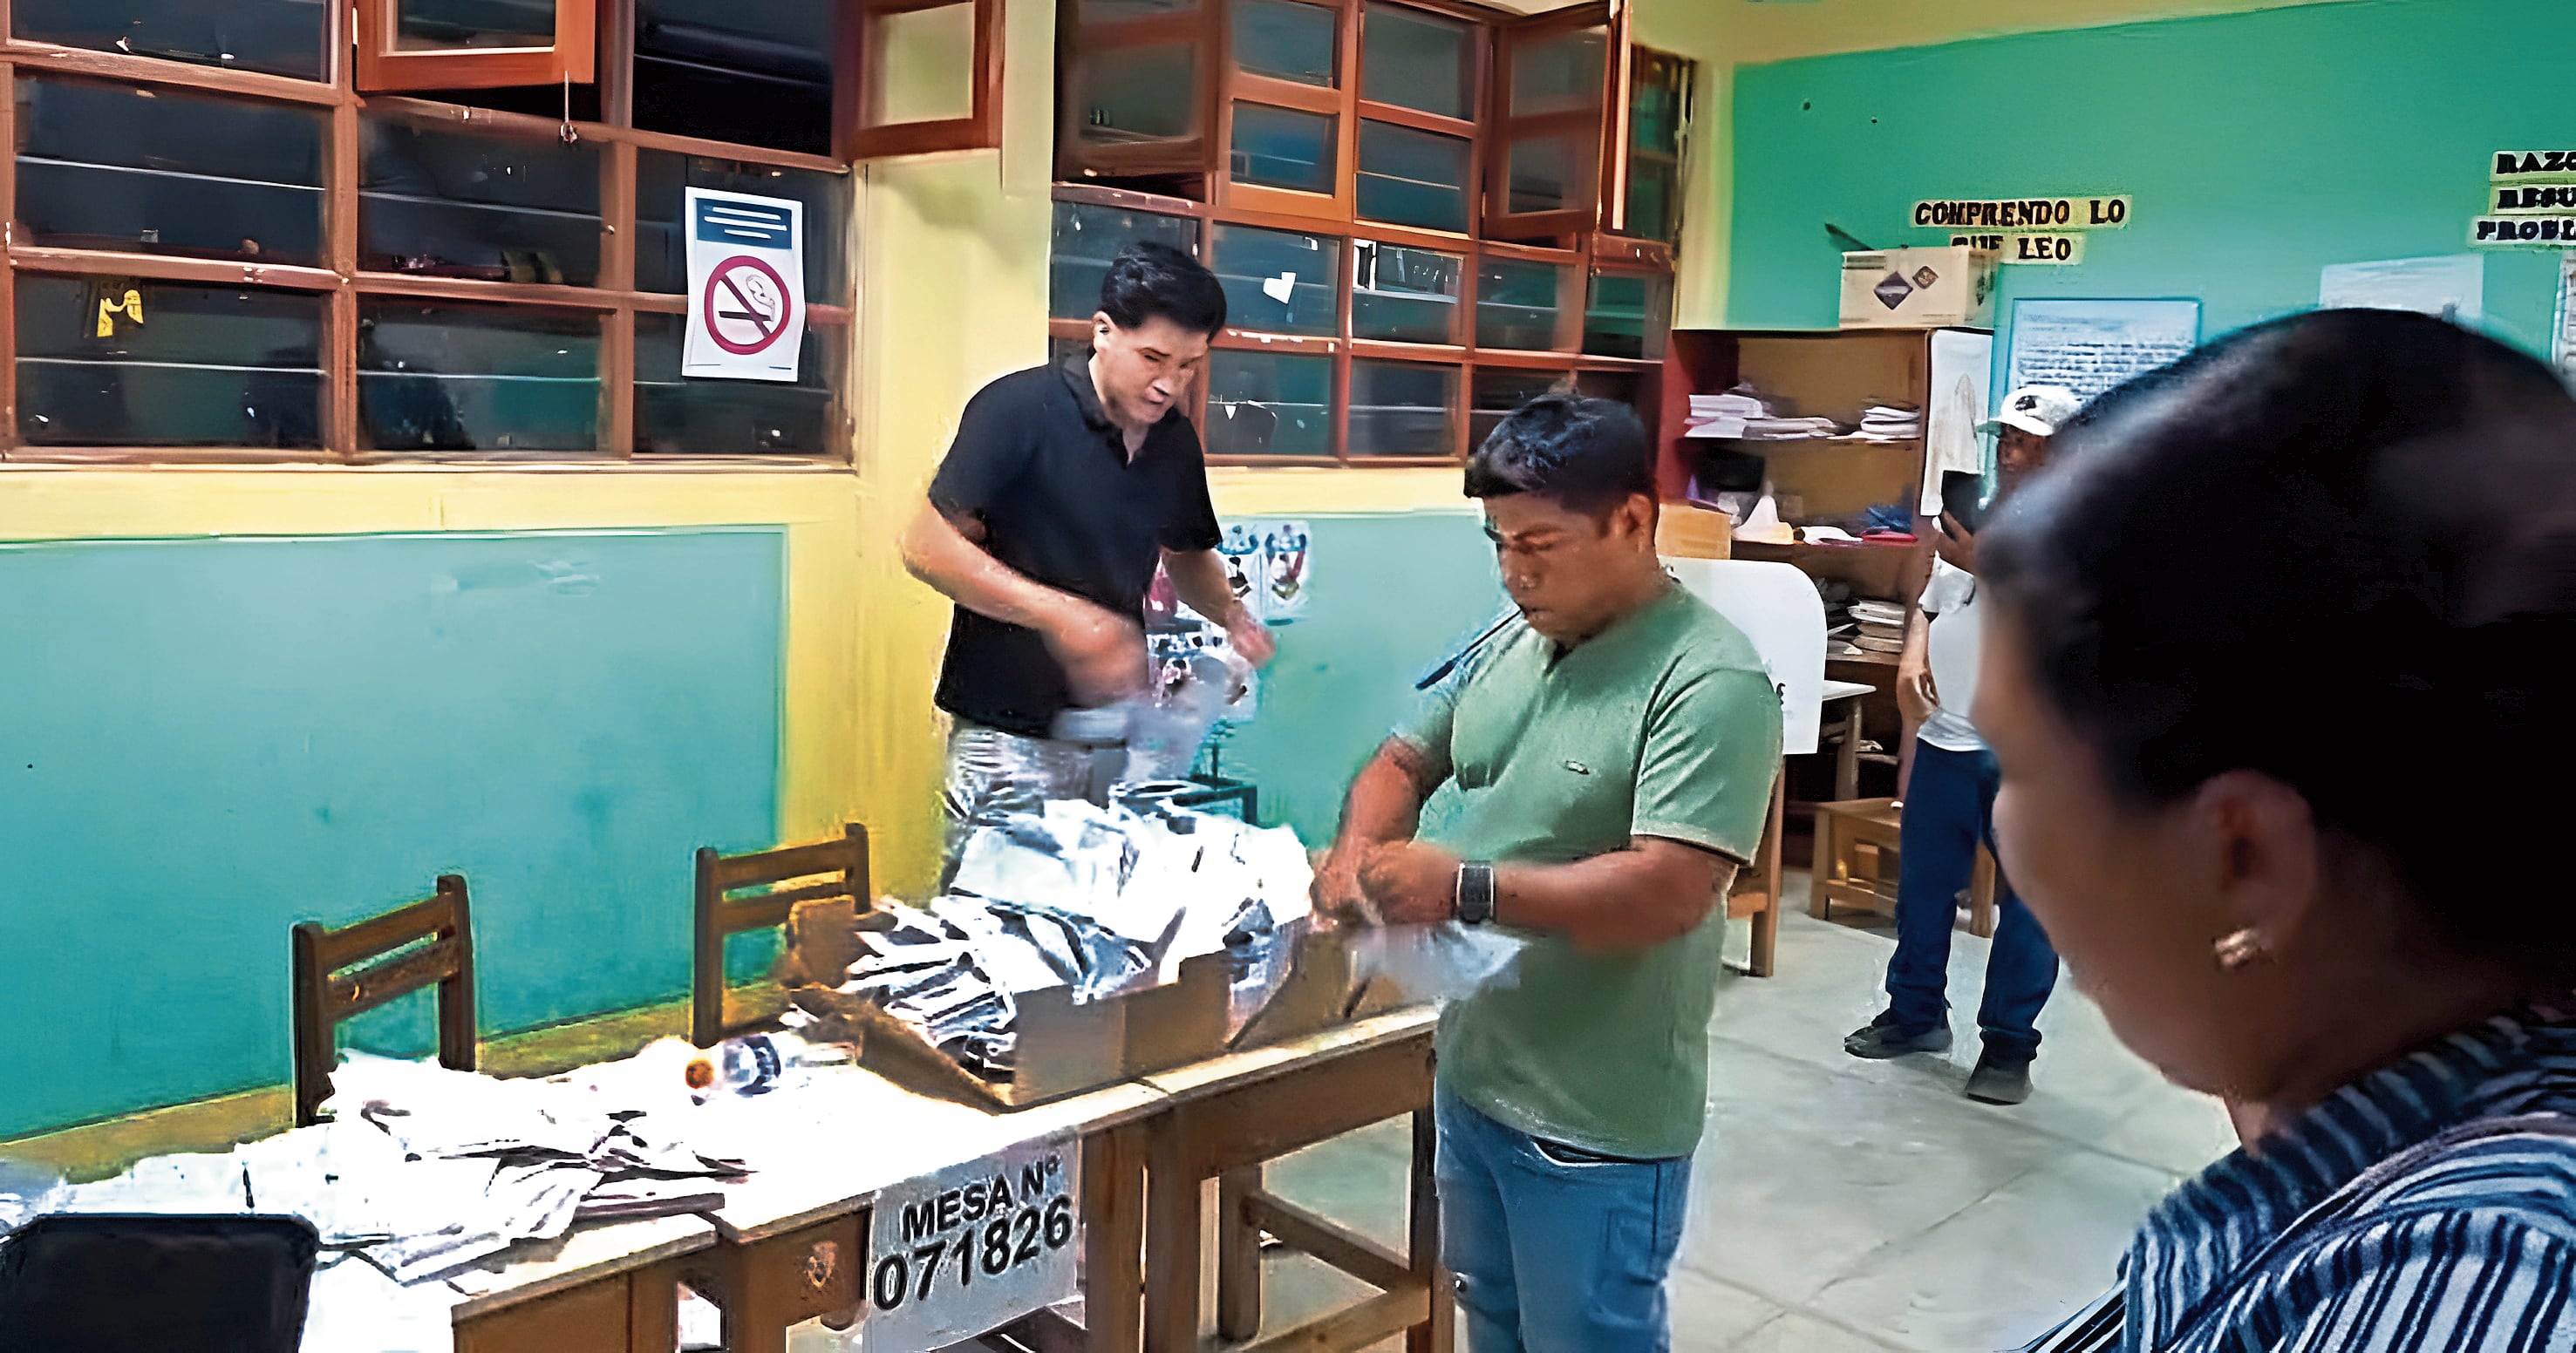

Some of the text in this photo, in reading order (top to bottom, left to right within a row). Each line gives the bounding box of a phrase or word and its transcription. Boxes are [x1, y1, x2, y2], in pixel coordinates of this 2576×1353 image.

[1914, 199, 2126, 227] COMPRENDO LO
[2018, 236, 2072, 261] LEO
[902, 1173, 1014, 1244] MESA
[873, 1193, 1074, 1311] 071826
